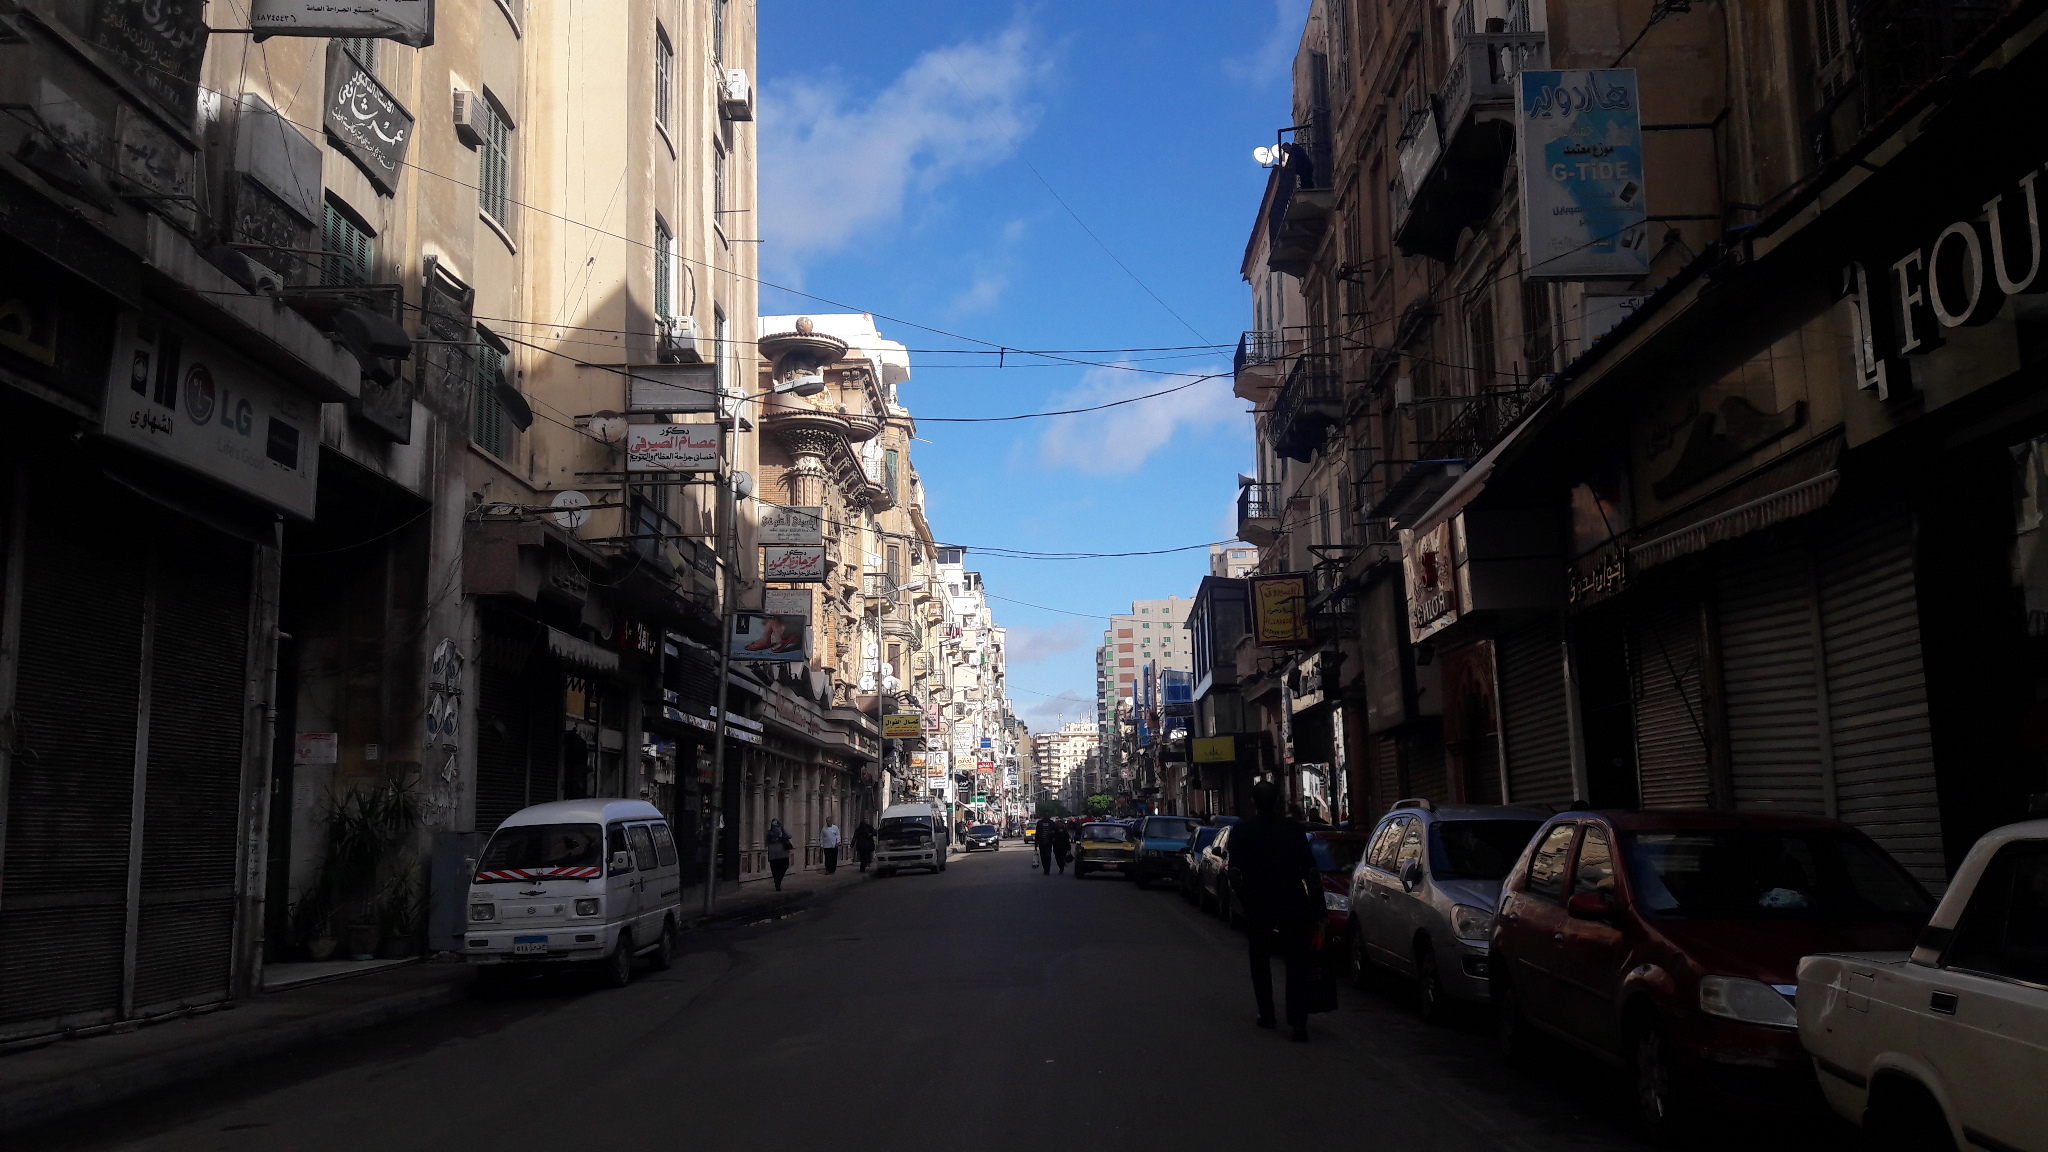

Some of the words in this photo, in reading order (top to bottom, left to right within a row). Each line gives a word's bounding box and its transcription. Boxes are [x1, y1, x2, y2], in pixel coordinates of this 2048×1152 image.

[326, 4, 352, 13] الجراحة
[1529, 71, 1631, 119] هاردوير
[1563, 143, 1592, 156] معتمد
[1592, 142, 1614, 158] موزع
[1892, 163, 2048, 355] FOU
[220, 388, 253, 438] LG
[659, 426, 690, 436] دكتور
[679, 435, 717, 451] عصام
[654, 452, 674, 461] العظام
[674, 452, 694, 461] جراحة
[785, 555, 809, 570] حافظ
[903, 718, 919, 726] كمال
